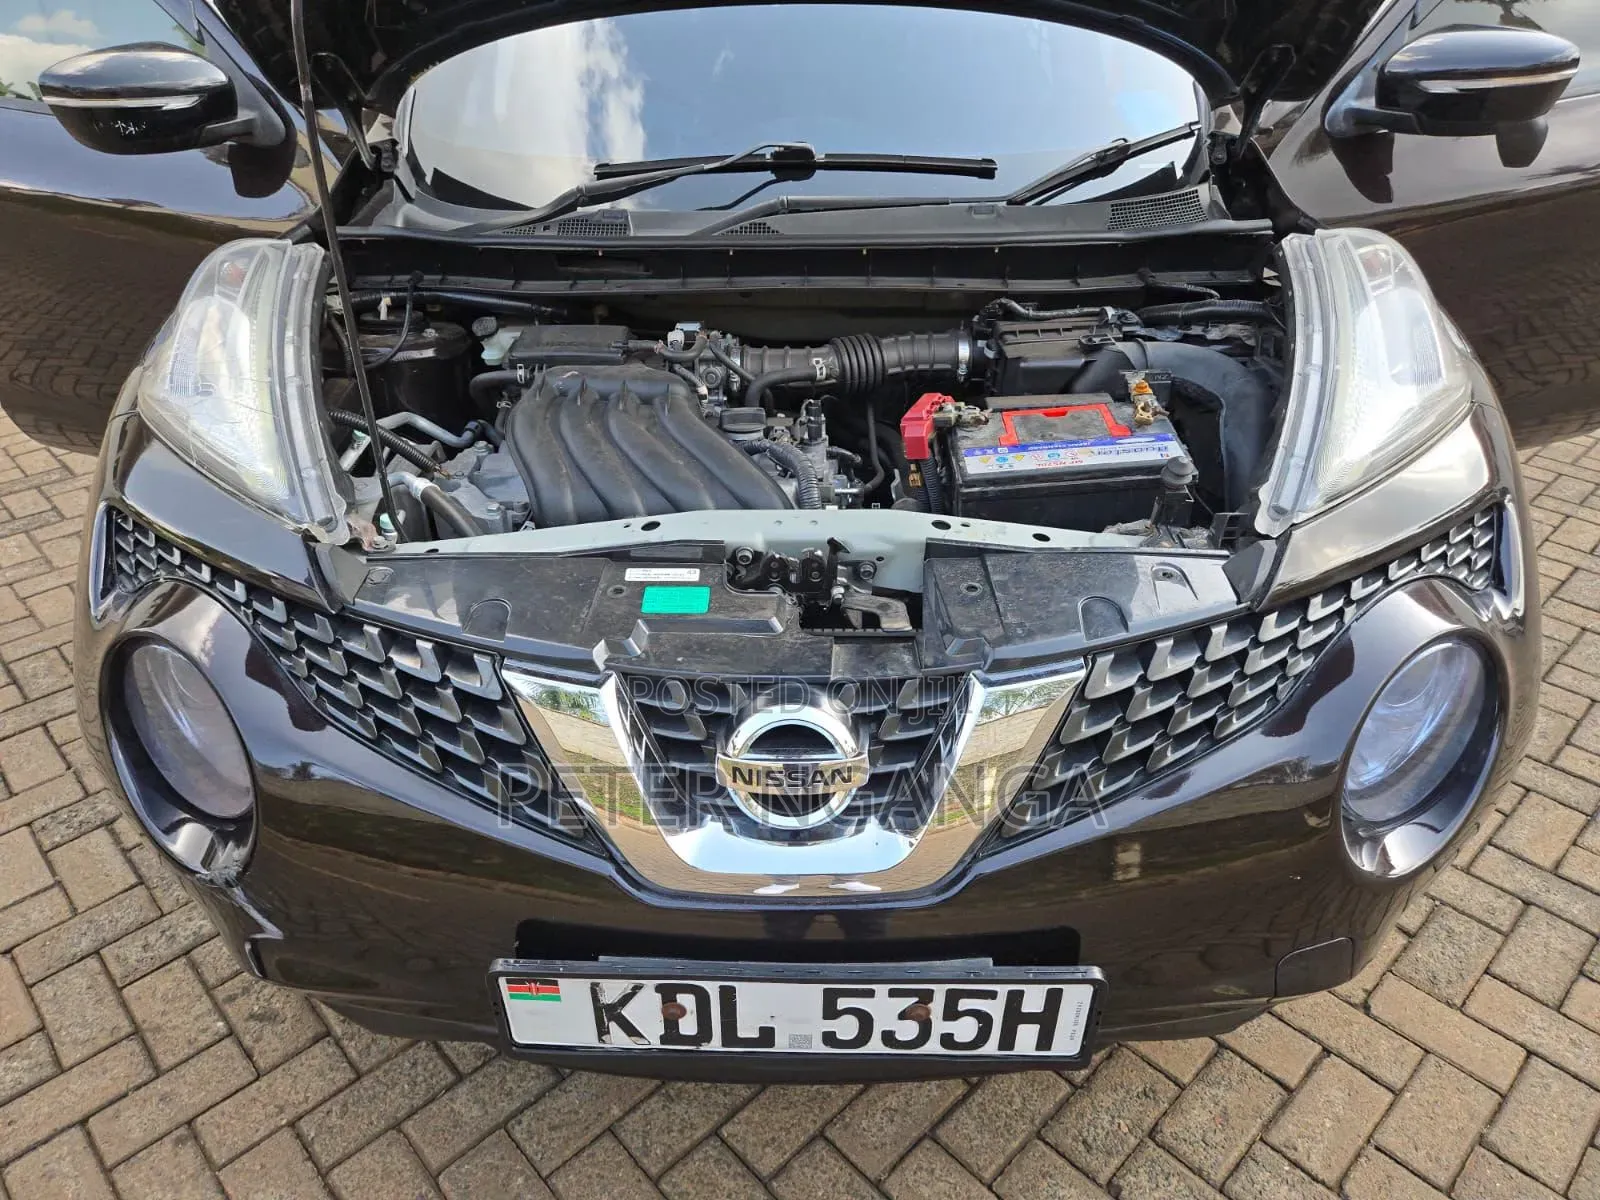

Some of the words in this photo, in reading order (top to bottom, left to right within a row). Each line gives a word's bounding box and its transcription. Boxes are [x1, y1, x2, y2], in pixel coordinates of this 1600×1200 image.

[732, 765, 852, 788] NISSAN
[591, 982, 777, 1048] KDL
[821, 987, 1064, 1052] 535H
